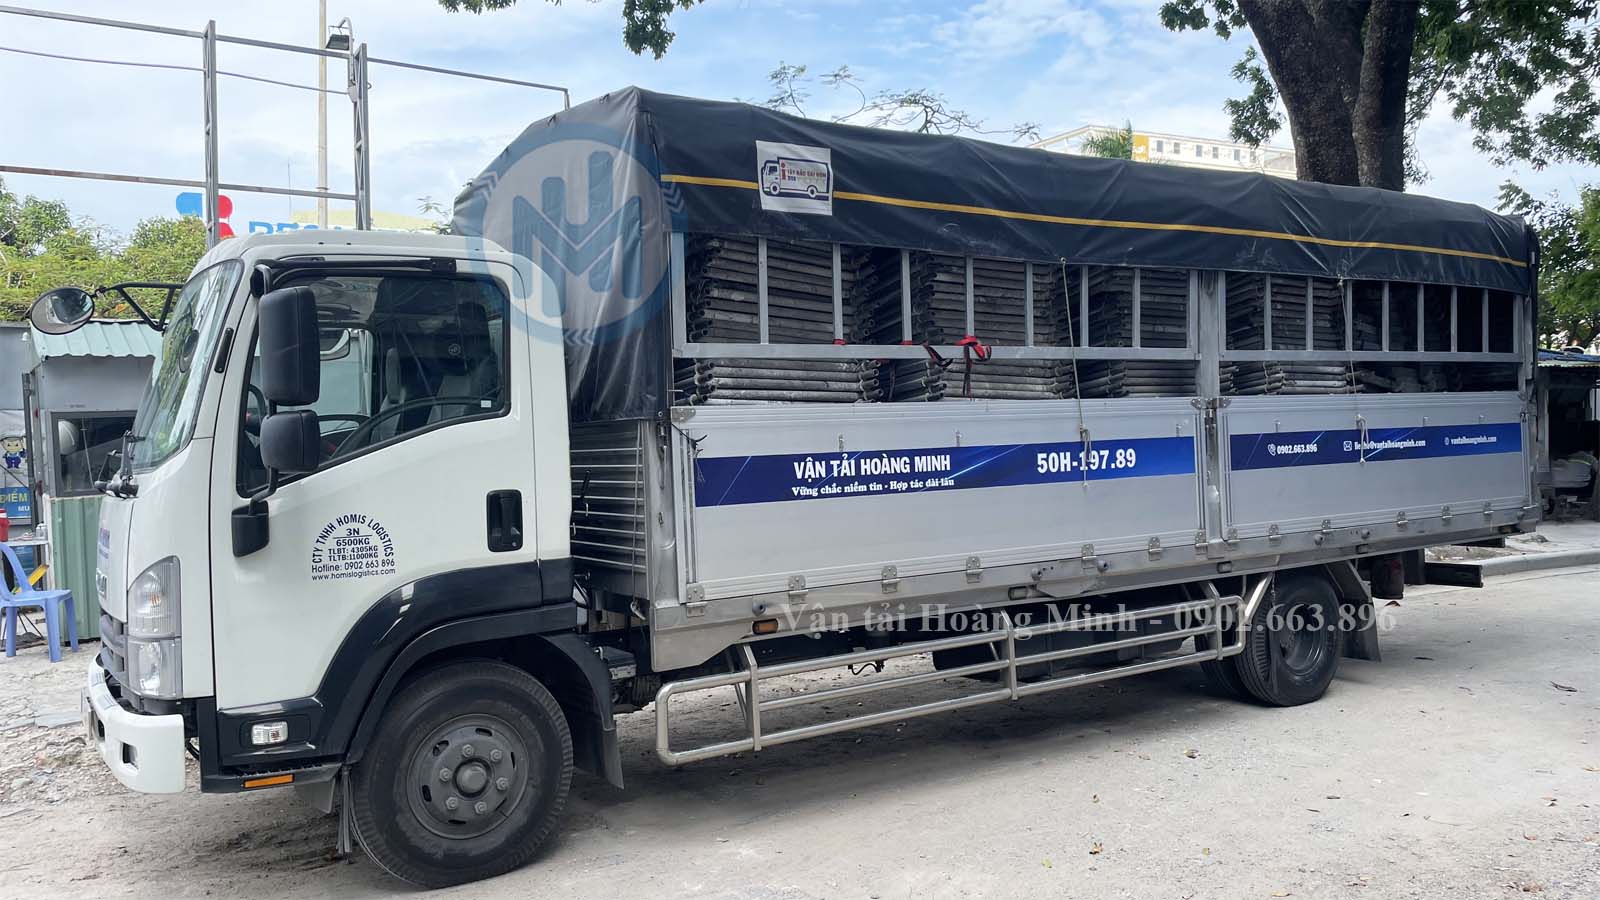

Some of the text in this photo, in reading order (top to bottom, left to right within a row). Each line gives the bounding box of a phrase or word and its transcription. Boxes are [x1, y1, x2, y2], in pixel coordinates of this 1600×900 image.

[1277, 444, 1318, 454] 0902.663.896
[1037, 448, 1136, 473] 50H-197.89
[794, 453, 950, 482] VẬN TẢI HOÀNG MINH
[792, 486, 818, 496] Vững
[820, 482, 842, 494] chắc
[844, 481, 868, 493] niềm
[869, 481, 883, 492] tin
[890, 480, 908, 493] Hợp
[910, 479, 924, 489] tác
[925, 478, 939, 488] dài
[312, 514, 394, 563] CTY TNHH HOMIS LOGISTICS
[346, 528, 360, 536] 3N
[336, 538, 370, 546] 6500KG
[350, 546, 378, 554] 4305KG
[312, 558, 395, 573] Hotline: 0902 663 896
[312, 568, 396, 580] www.homislogistics.com
